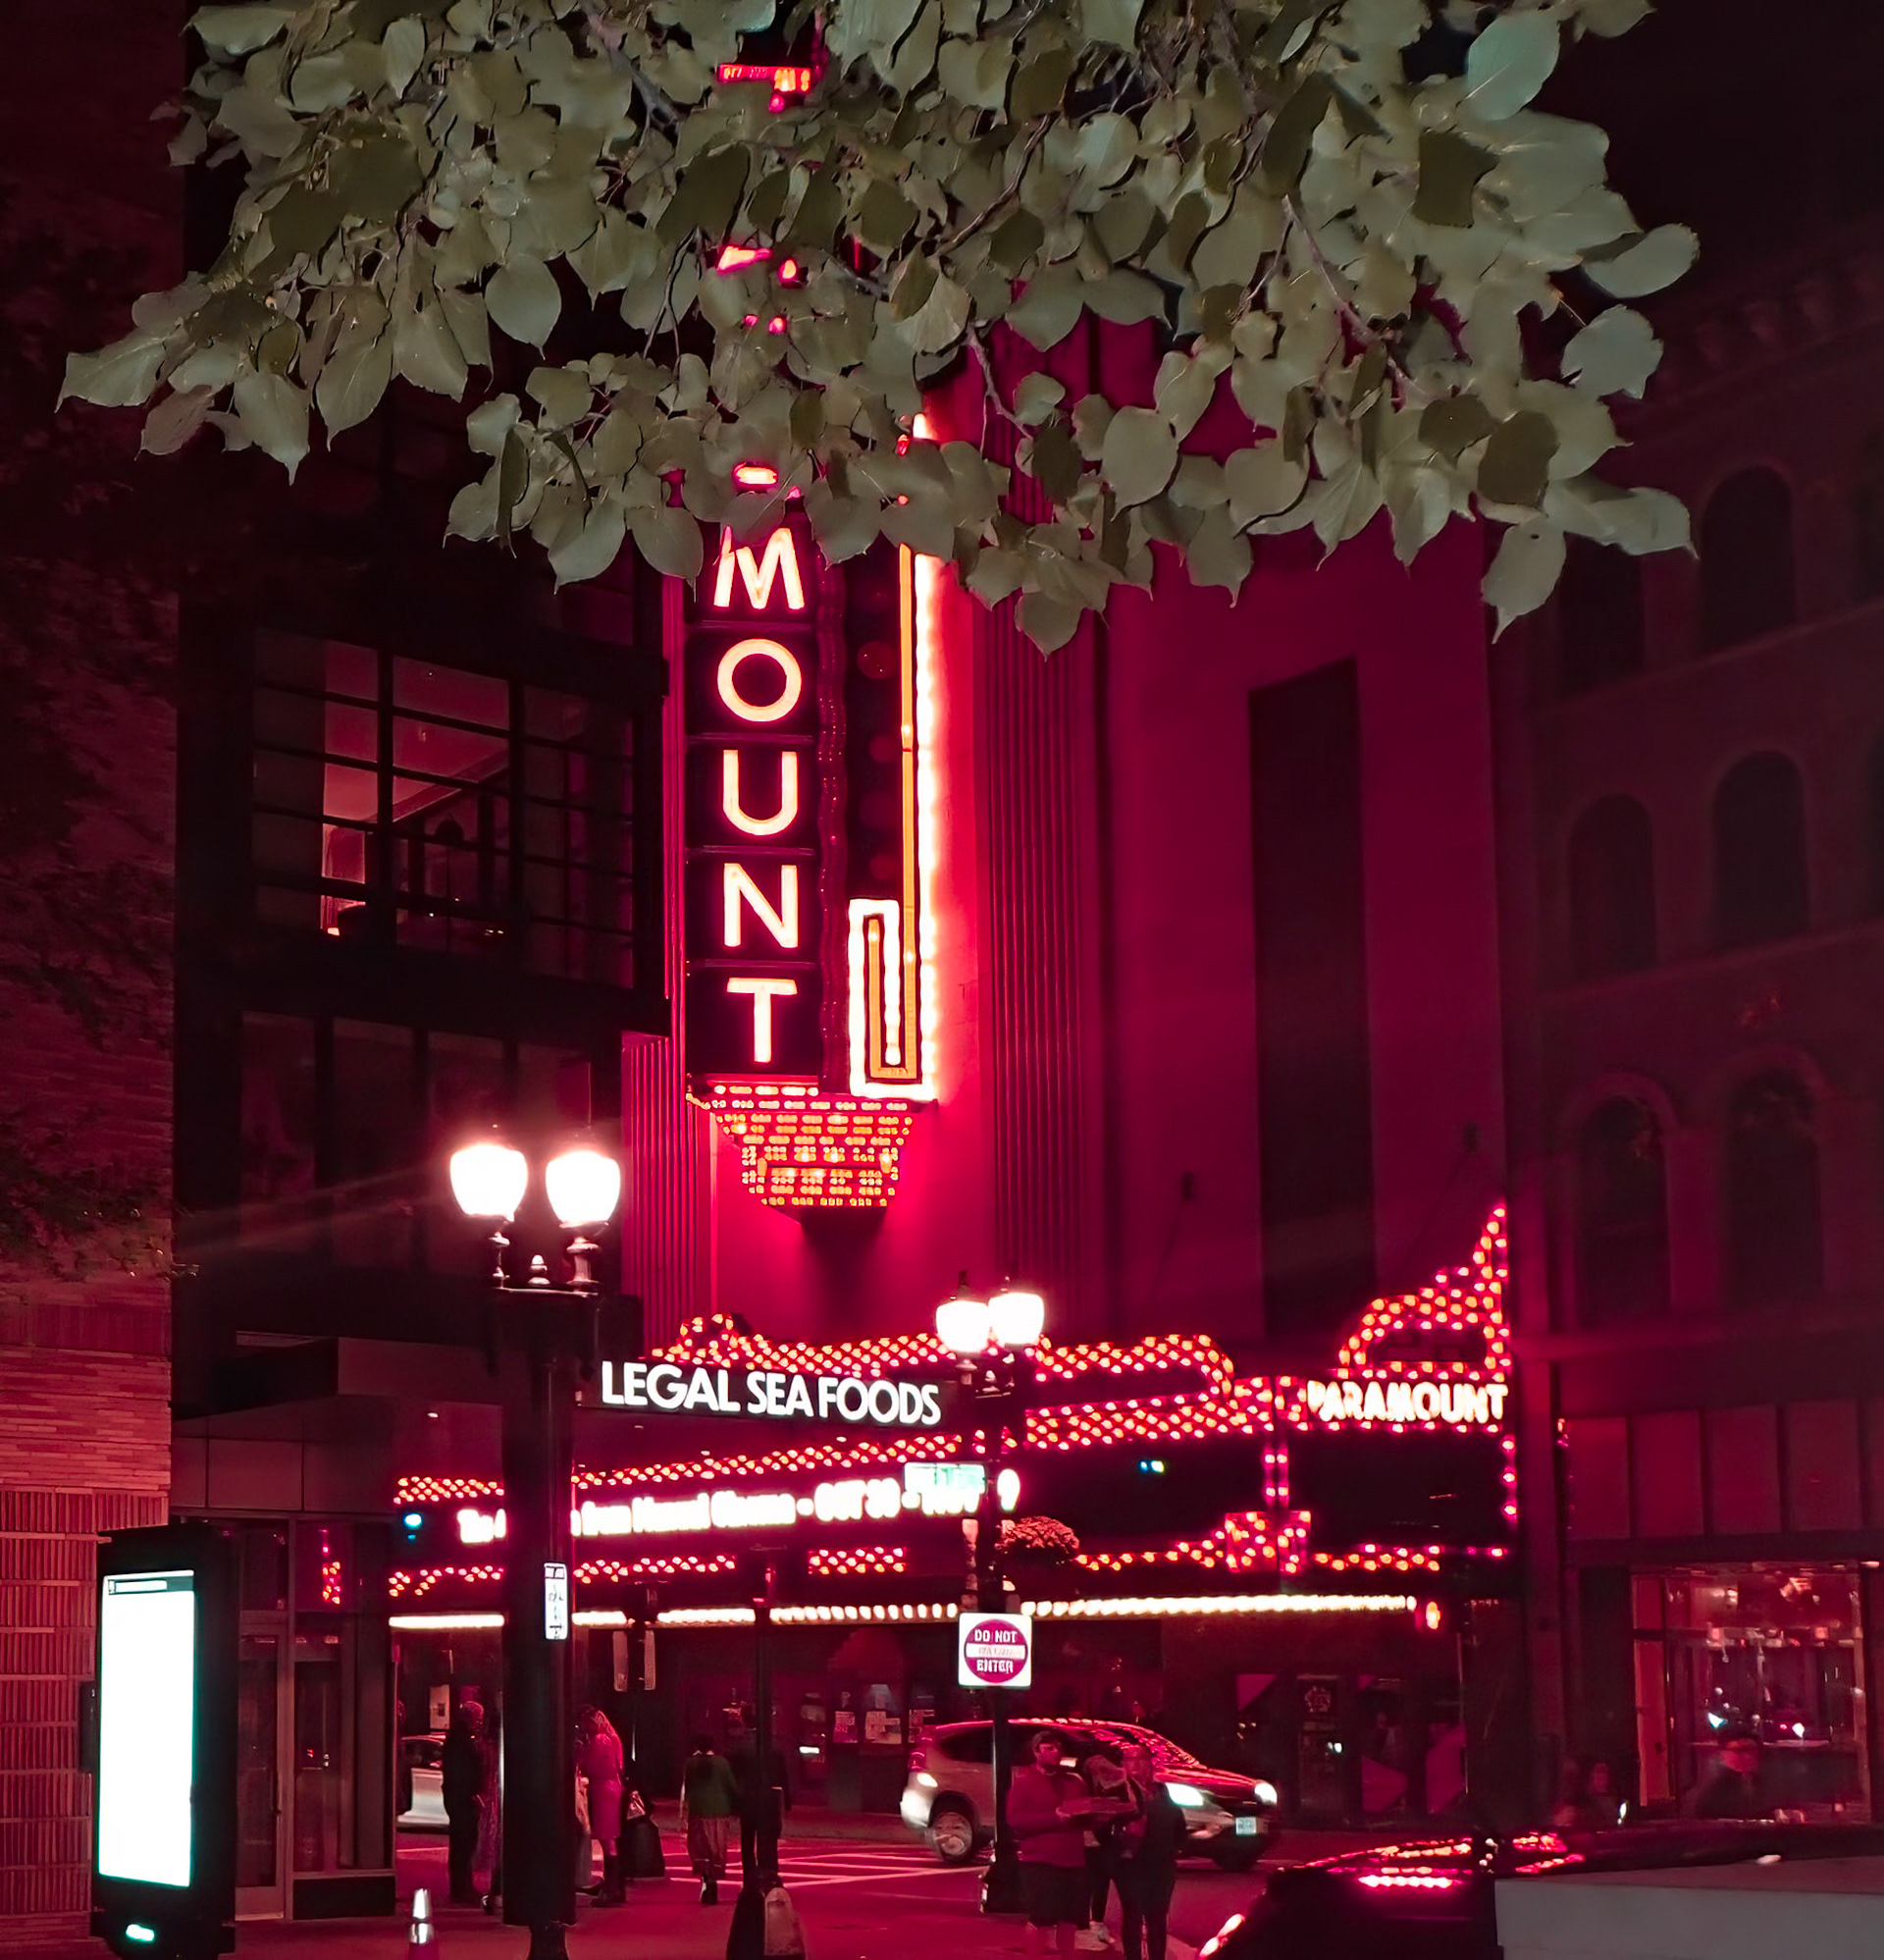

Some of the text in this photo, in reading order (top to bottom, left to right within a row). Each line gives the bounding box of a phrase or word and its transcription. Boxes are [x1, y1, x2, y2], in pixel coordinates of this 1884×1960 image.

[602, 1361, 941, 1425] LEGAL SEA FOODS
[1307, 1380, 1508, 1423] PARAMOUNT
[974, 1629, 1018, 1643] DO NOT
[976, 1660, 1013, 1673] ENTER
